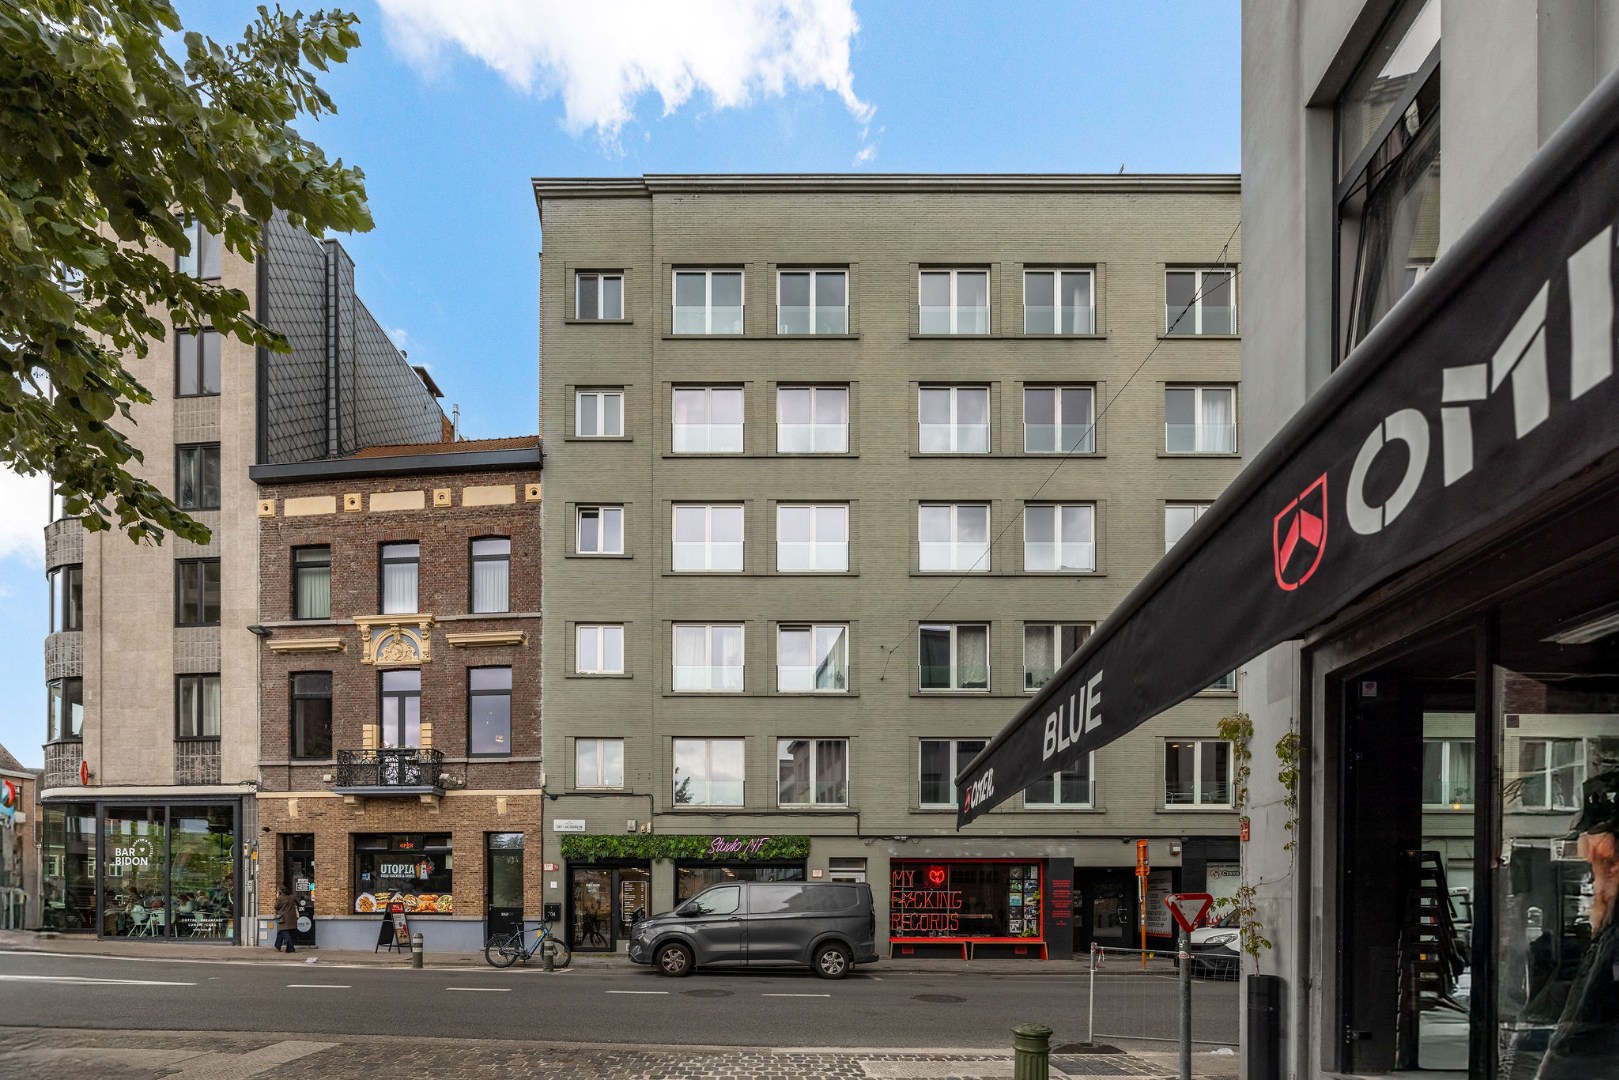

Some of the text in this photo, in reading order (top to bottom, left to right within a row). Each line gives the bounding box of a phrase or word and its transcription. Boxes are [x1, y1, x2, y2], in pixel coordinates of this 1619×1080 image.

[1042, 669, 1103, 762] BLUE
[115, 847, 136, 857] BAR
[707, 836, 770, 855] Studio NF
[115, 856, 148, 866] BIDON
[380, 863, 415, 874] UTOPIA
[892, 869, 915, 888] MY
[891, 912, 960, 931] RECORDS
